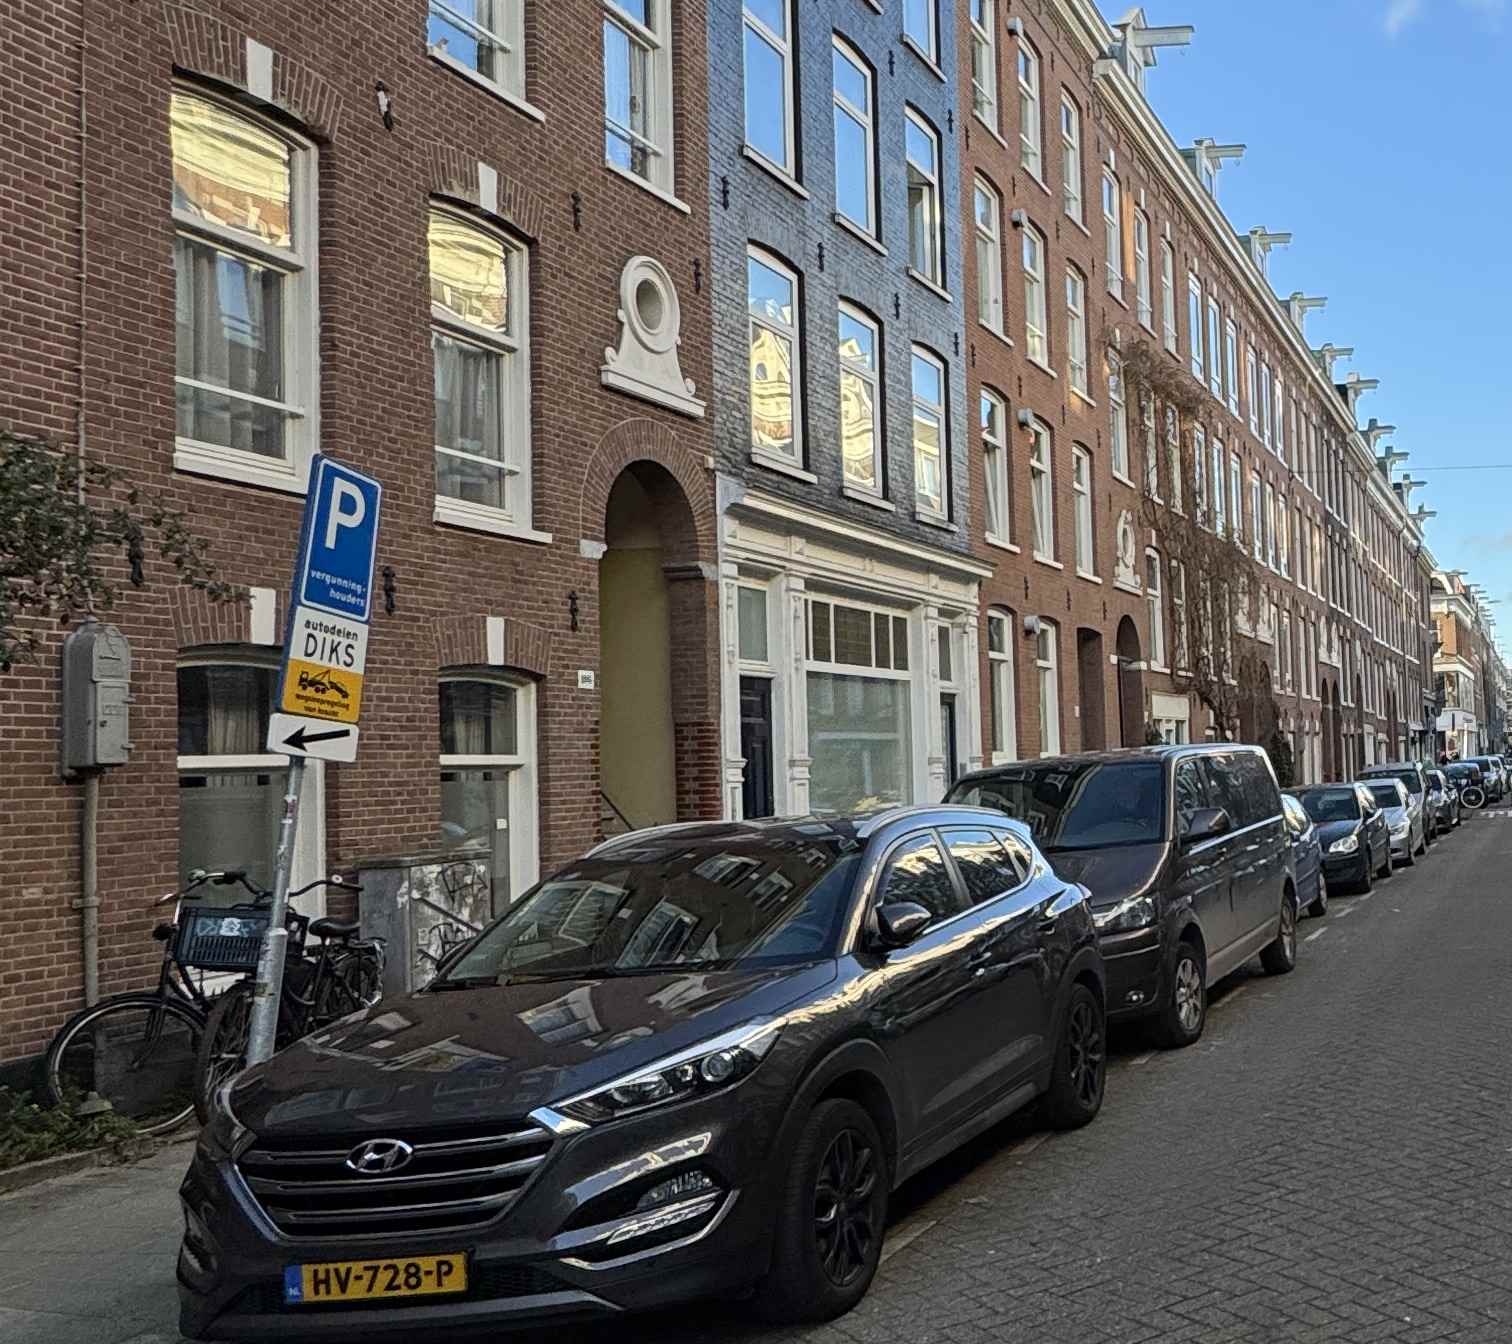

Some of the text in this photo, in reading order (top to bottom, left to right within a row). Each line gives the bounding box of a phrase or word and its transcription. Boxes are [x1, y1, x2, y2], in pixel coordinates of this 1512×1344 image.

[324, 476, 366, 550] P
[304, 619, 359, 642] autodelen
[303, 632, 355, 668] DIKS
[313, 1260, 454, 1296] HV-728-P
